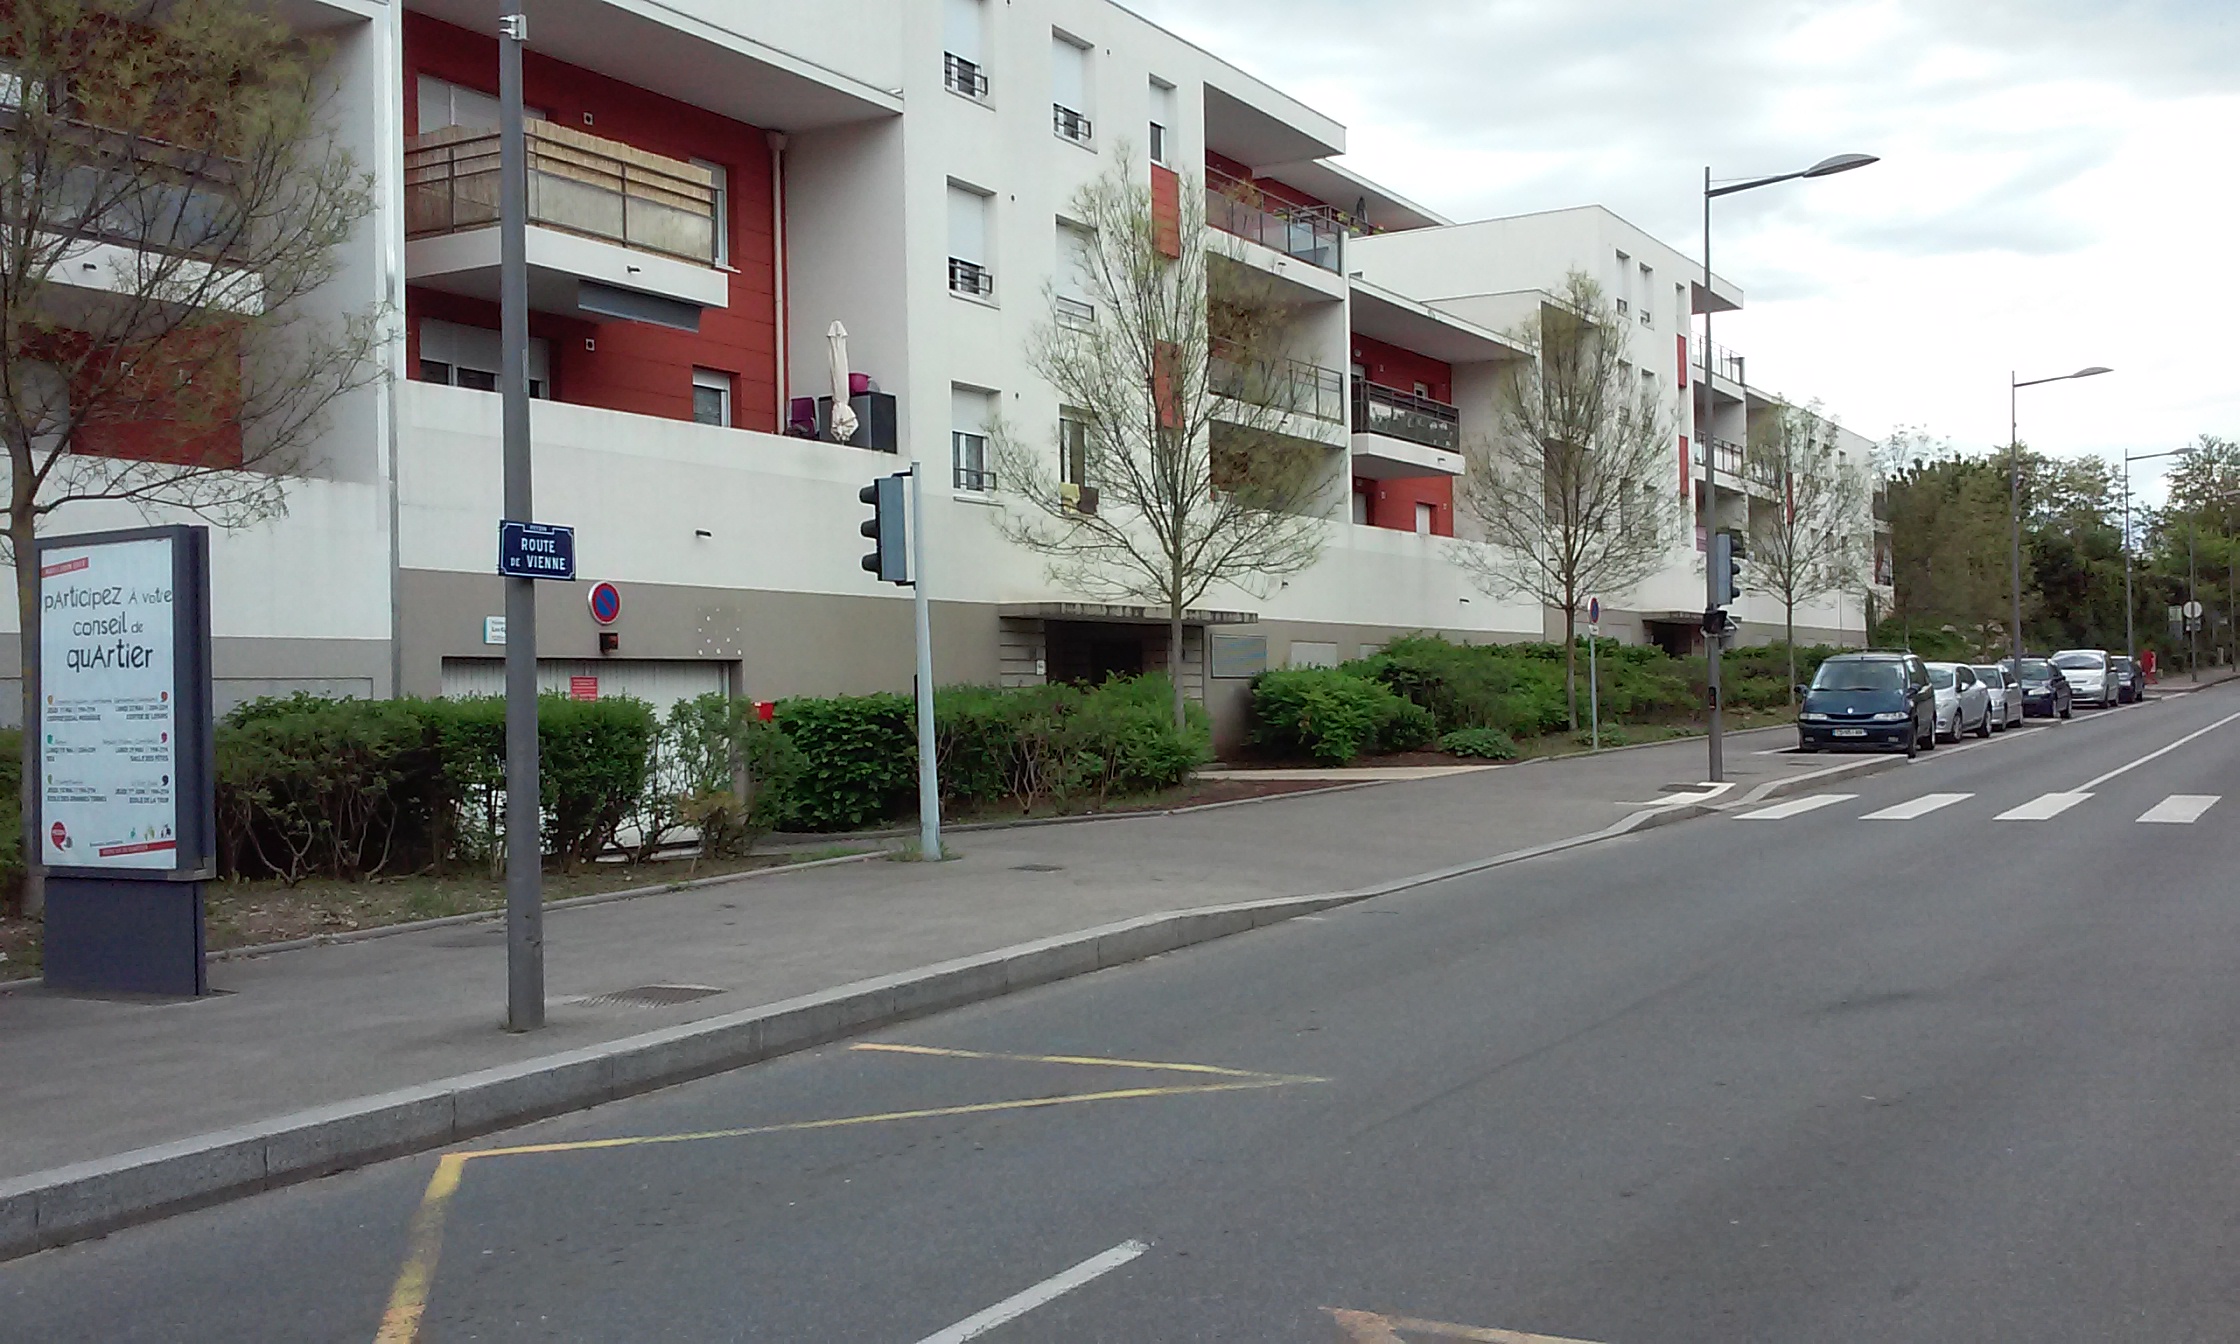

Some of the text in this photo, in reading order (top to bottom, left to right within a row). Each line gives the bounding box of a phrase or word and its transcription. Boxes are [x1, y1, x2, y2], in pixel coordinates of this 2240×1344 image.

[521, 537, 555, 553] ROUTE
[510, 555, 566, 570] DE VIENNE
[73, 611, 143, 636] conseil de
